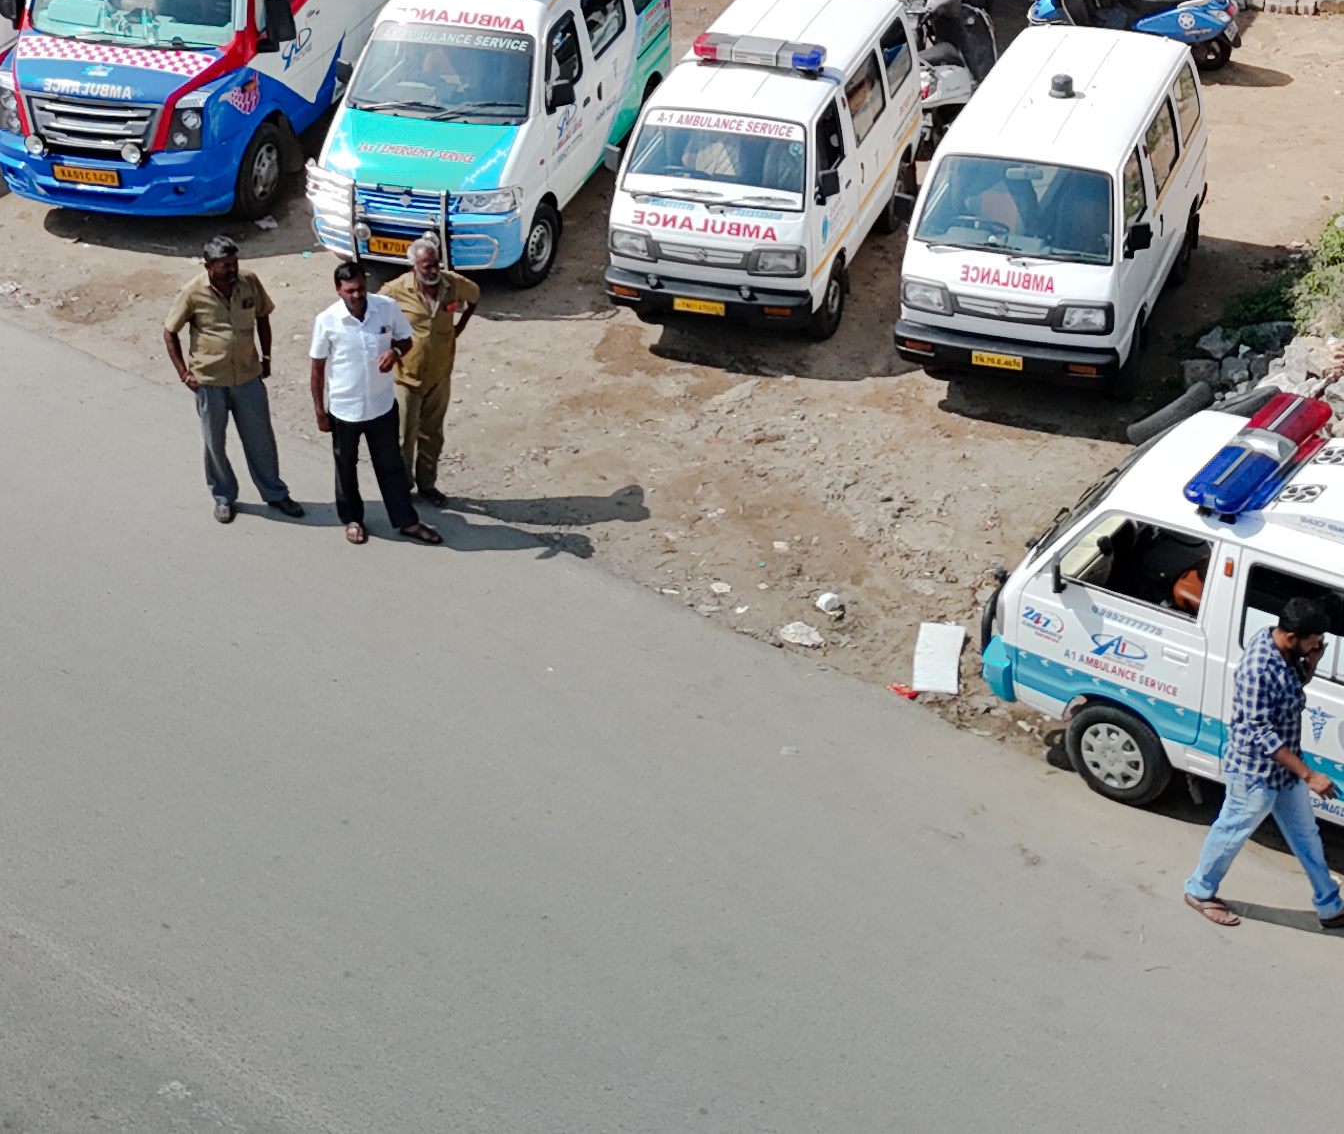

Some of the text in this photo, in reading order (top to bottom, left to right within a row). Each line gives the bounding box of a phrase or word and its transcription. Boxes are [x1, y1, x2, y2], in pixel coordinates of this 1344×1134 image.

[474, 35, 529, 53] SERVICE
[656, 111, 796, 139] A-1 AMBULANCE SERVICE
[381, 143, 438, 159] EMERGENCY
[439, 149, 478, 165] SERVICE
[1064, 649, 1179, 697] A1 AMBULANCE SERVICE
